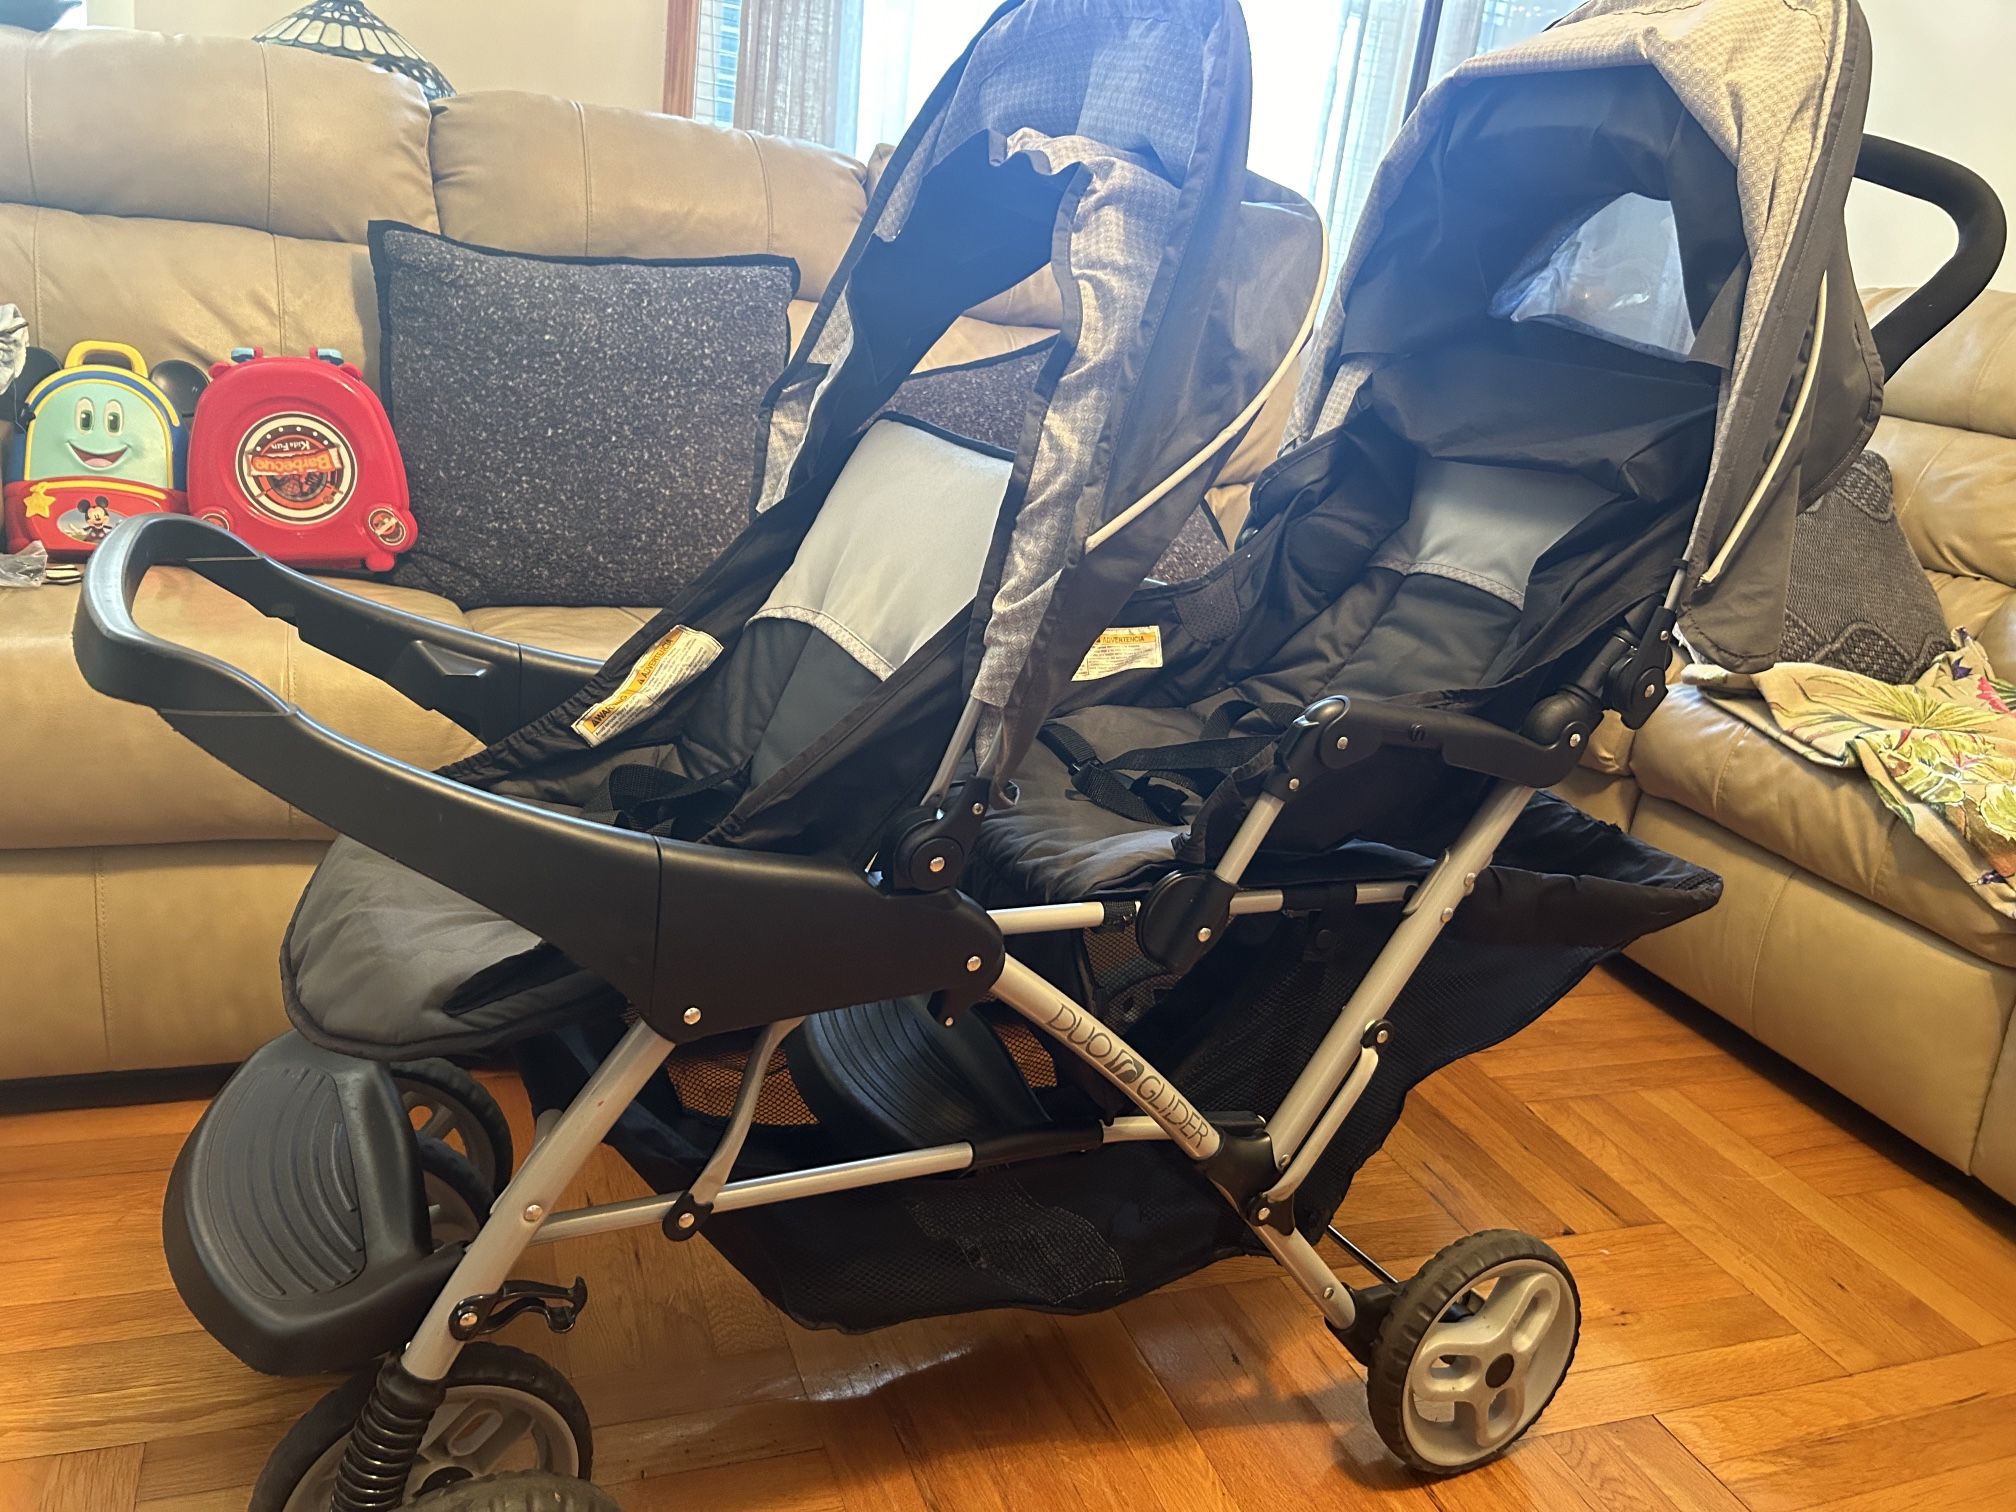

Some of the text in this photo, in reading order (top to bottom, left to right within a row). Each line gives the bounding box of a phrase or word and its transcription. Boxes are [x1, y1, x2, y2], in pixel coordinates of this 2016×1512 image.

[271, 440, 311, 451] Kids Fun
[253, 450, 332, 472] Barbecue
[1102, 636, 1145, 644] ADVERTENCIA
[641, 639, 674, 678] ADVERTENCIA
[595, 694, 628, 722] WARNING
[1046, 1004, 1112, 1058] DUO
[1136, 1075, 1209, 1149] GLIDER
